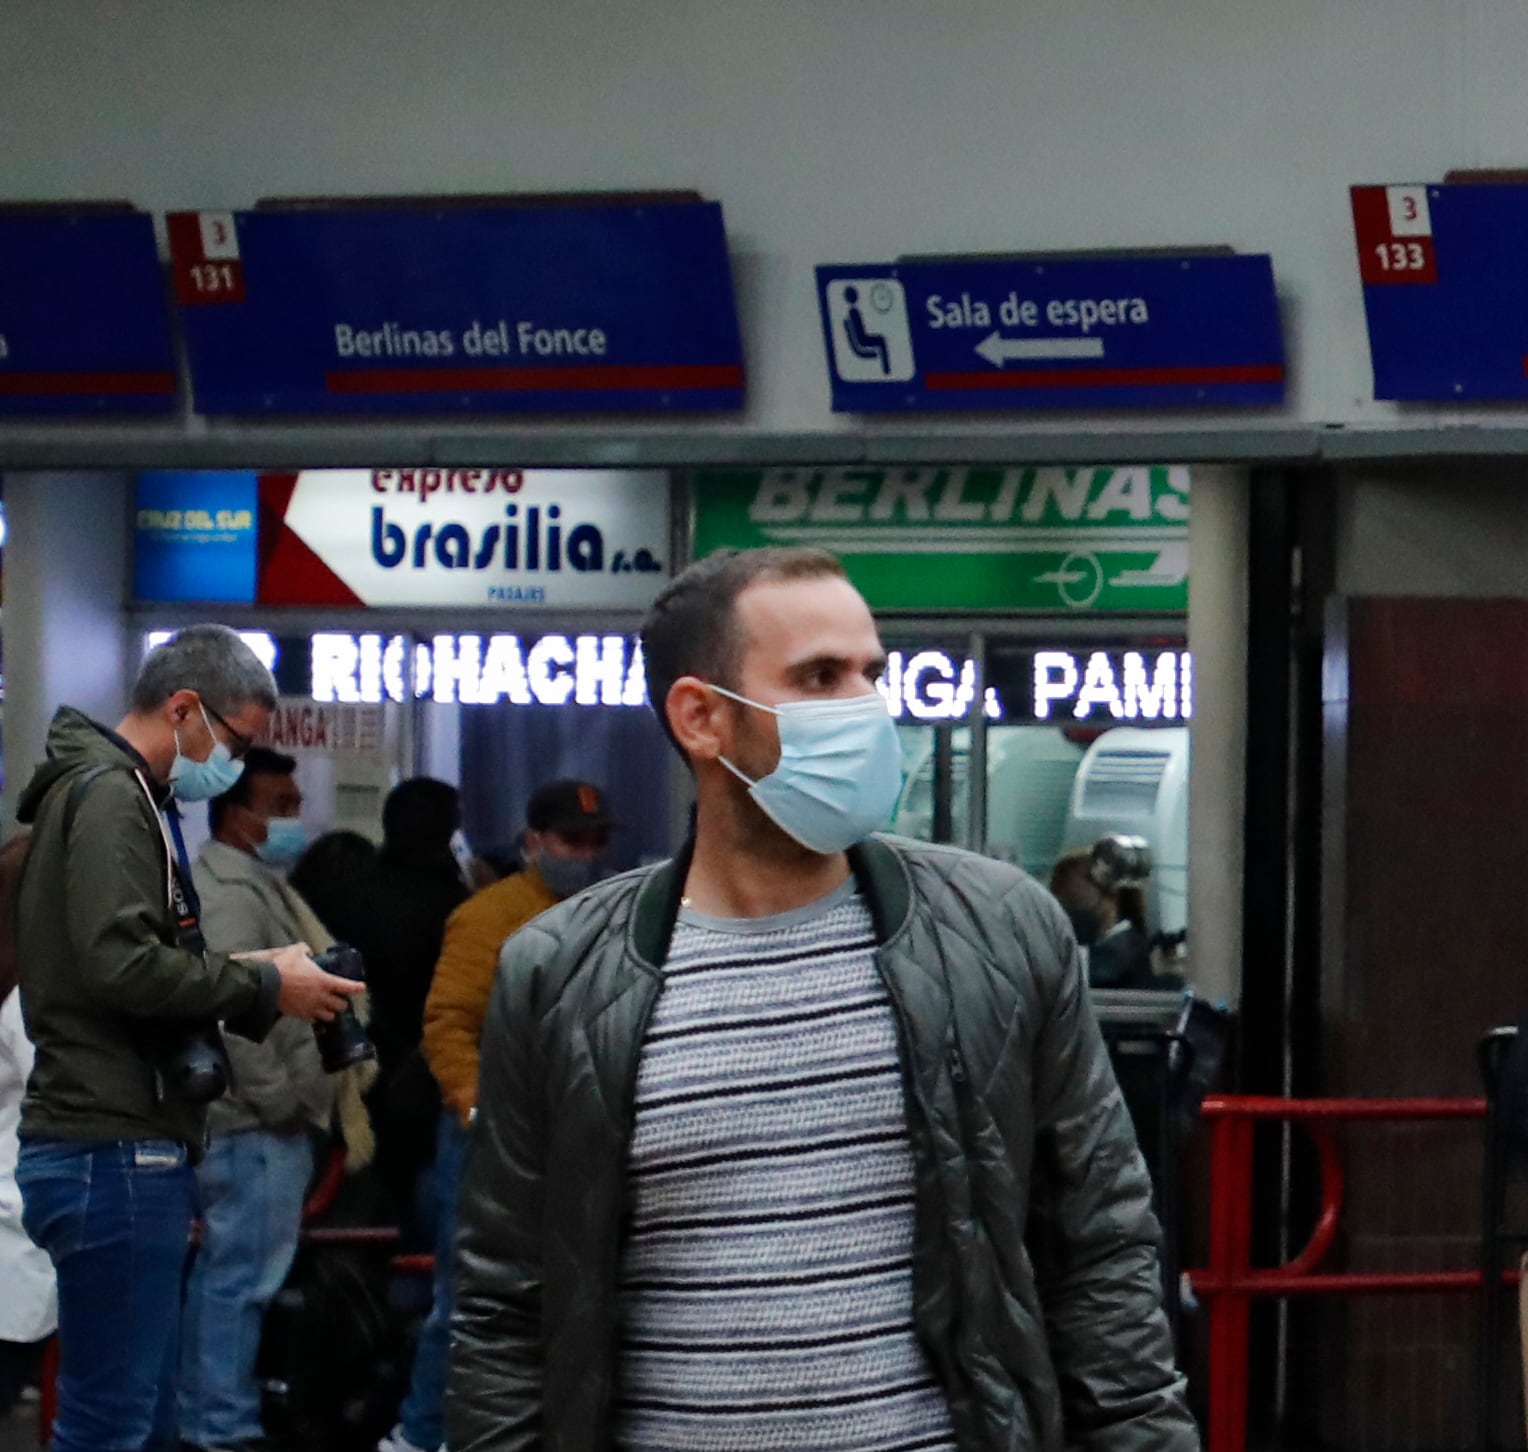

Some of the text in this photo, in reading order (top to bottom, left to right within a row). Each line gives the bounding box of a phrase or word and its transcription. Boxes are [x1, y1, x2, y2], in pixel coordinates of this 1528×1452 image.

[1403, 195, 1417, 220] 3
[213, 221, 226, 245] 3
[1375, 243, 1424, 270] 133
[190, 264, 232, 292] 131
[927, 294, 1149, 333] Sala de espera
[335, 320, 607, 357] Berlinas del Fonce
[371, 504, 603, 571] brasilia
